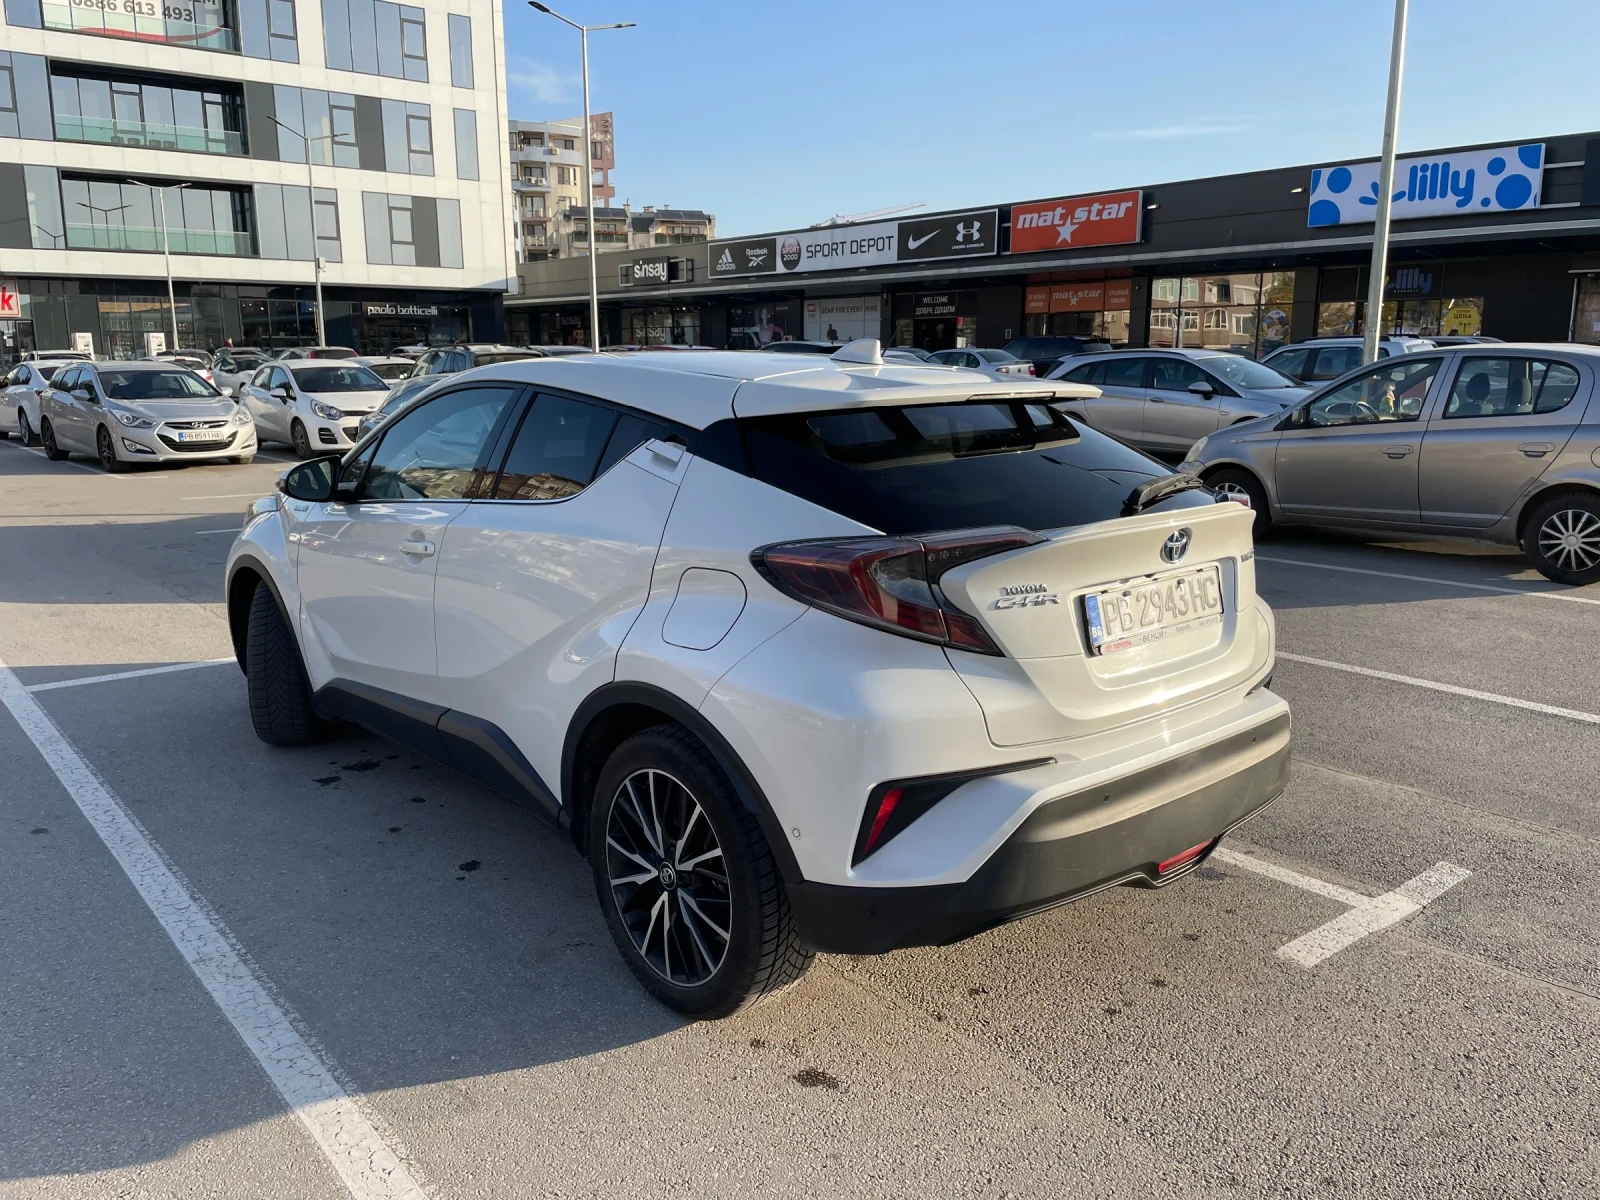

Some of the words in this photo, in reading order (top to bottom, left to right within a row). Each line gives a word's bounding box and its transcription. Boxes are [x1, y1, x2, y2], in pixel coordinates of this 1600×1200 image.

[123, 1, 156, 16] 613
[162, 6, 193, 22] 493
[1408, 161, 1475, 208] lilly
[1017, 207, 1066, 229] mat
[1073, 201, 1132, 223] star
[746, 247, 768, 256] Reebok
[781, 245, 800, 254] SPORT
[806, 240, 846, 259] SPORT
[851, 235, 894, 255] DEPOT
[634, 260, 667, 281] sinsay
[716, 262, 736, 271] adidas
[1395, 268, 1432, 294] lilly
[922, 295, 948, 304] WELCOME
[1052, 290, 1074, 299] mat
[1076, 289, 1101, 298] star
[367, 304, 396, 316] paolo
[397, 304, 438, 316] botticelli
[847, 305, 863, 313] EVERY
[864, 304, 878, 312] HIKE
[915, 306, 934, 315] ДОБРЕ
[934, 305, 956, 314] ДОШЛИ
[1004, 583, 1048, 596] TOYOTA
[994, 593, 1060, 610] C-HR
[1102, 595, 1135, 636] PB
[1136, 581, 1189, 627] 2943
[1189, 574, 1218, 613] HC
[1091, 625, 1103, 638] BG
[1113, 640, 1132, 650] TOYOTA
